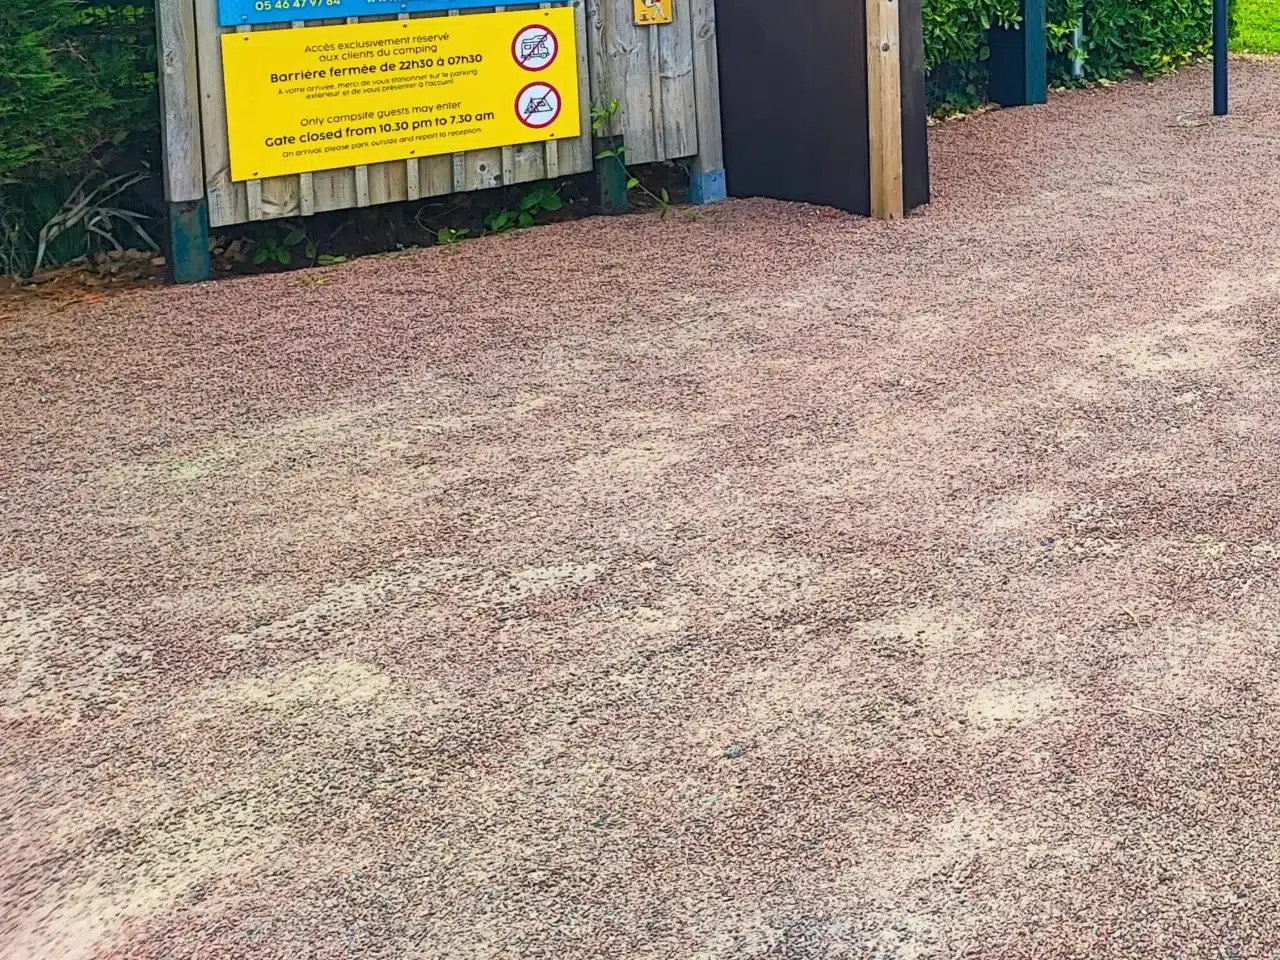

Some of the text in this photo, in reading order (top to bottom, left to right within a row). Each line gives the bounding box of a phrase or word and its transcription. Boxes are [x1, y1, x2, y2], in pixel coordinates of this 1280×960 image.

[255, 1, 271, 11] 05
[275, 0, 290, 9] 46
[304, 32, 449, 53] Accès exclusivement réservé
[319, 44, 437, 62] aux clients du camping
[270, 54, 483, 83] Barrière fermée de 22h30 à 07h30
[338, 81, 359, 89] merci
[361, 79, 370, 87] de
[391, 74, 427, 83] stationner
[450, 69, 478, 78] parking
[351, 87, 361, 95] de
[362, 86, 380, 94] vous
[382, 83, 416, 93] présenter
[425, 79, 454, 87] l'accueil
[300, 101, 462, 126] Only campsite guests may enter
[265, 112, 495, 147] Gate closed from 10.30 pm to 7.30 am
[282, 150, 294, 158] On
[324, 144, 349, 153] please
[351, 141, 370, 150] park
[370, 138, 398, 146] outside
[415, 133, 438, 141] report
[448, 127, 481, 137] reception
